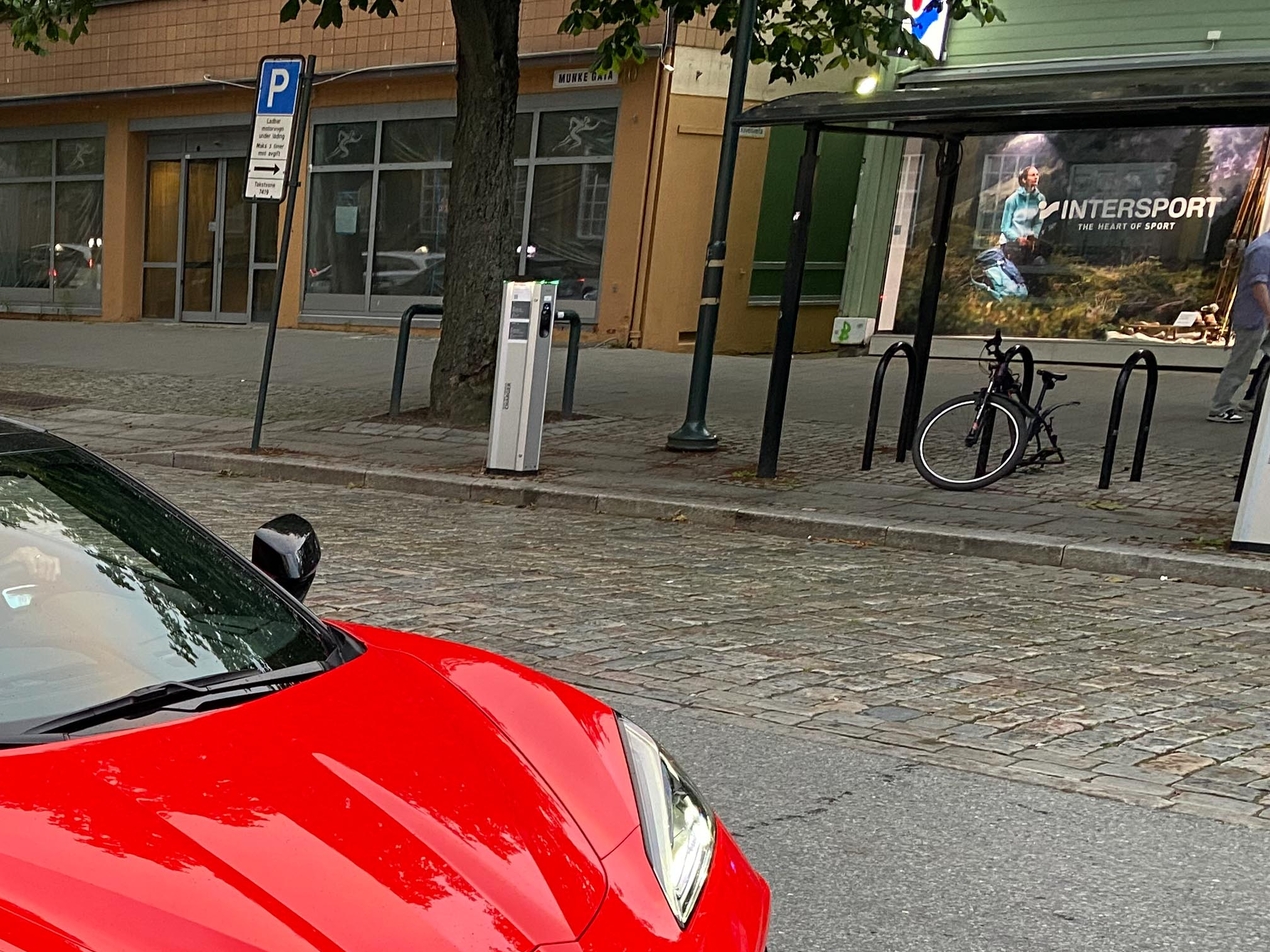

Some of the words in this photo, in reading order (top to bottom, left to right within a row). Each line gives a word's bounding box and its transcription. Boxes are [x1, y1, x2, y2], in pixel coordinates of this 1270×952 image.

[558, 73, 588, 83] MUNKE
[267, 68, 290, 108] P
[1060, 196, 1222, 220] INTERSPORT
[1078, 223, 1094, 231] THE
[1097, 222, 1127, 231] HEART
[1130, 222, 1142, 230] OF
[1144, 221, 1176, 230] SPORT
